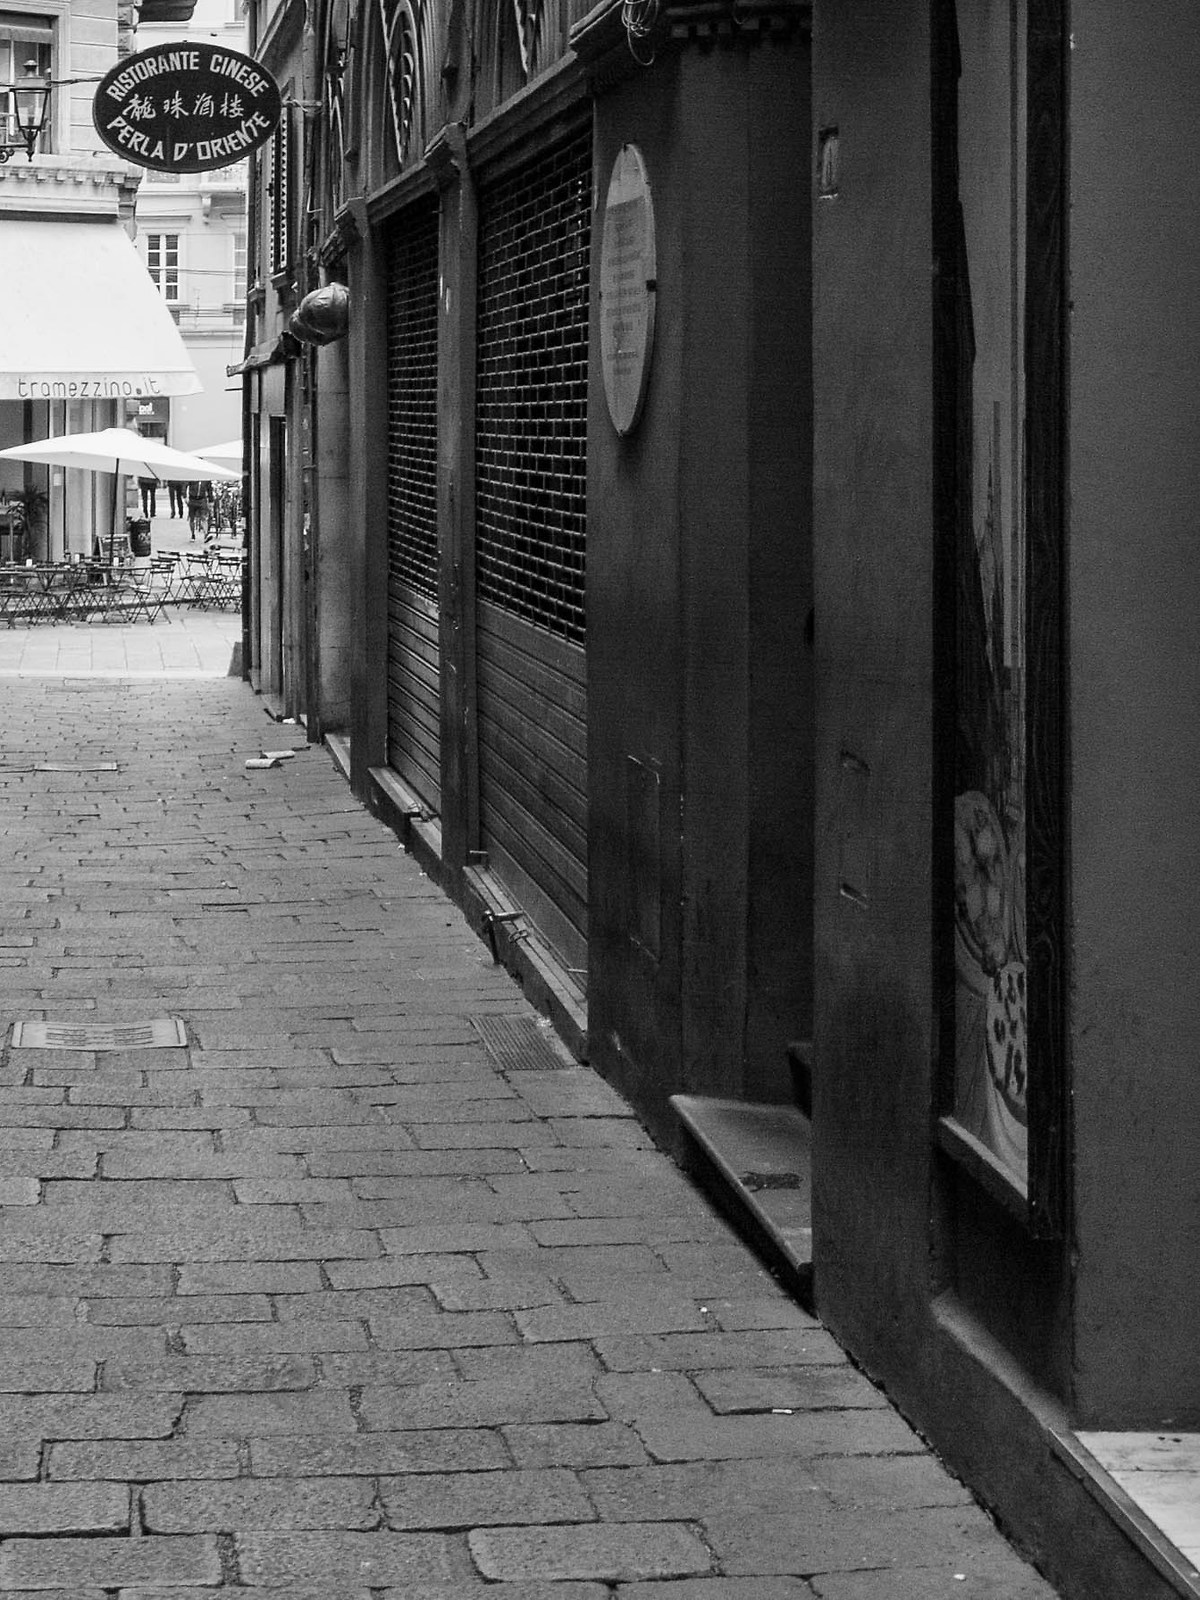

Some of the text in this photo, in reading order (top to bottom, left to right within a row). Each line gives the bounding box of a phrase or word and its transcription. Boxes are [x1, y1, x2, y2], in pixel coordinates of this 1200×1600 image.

[106, 51, 269, 102] RISTORANTE CINESE
[106, 111, 271, 162] PERLA D'ORIENTE
[18, 377, 161, 397] tramezzino.it
